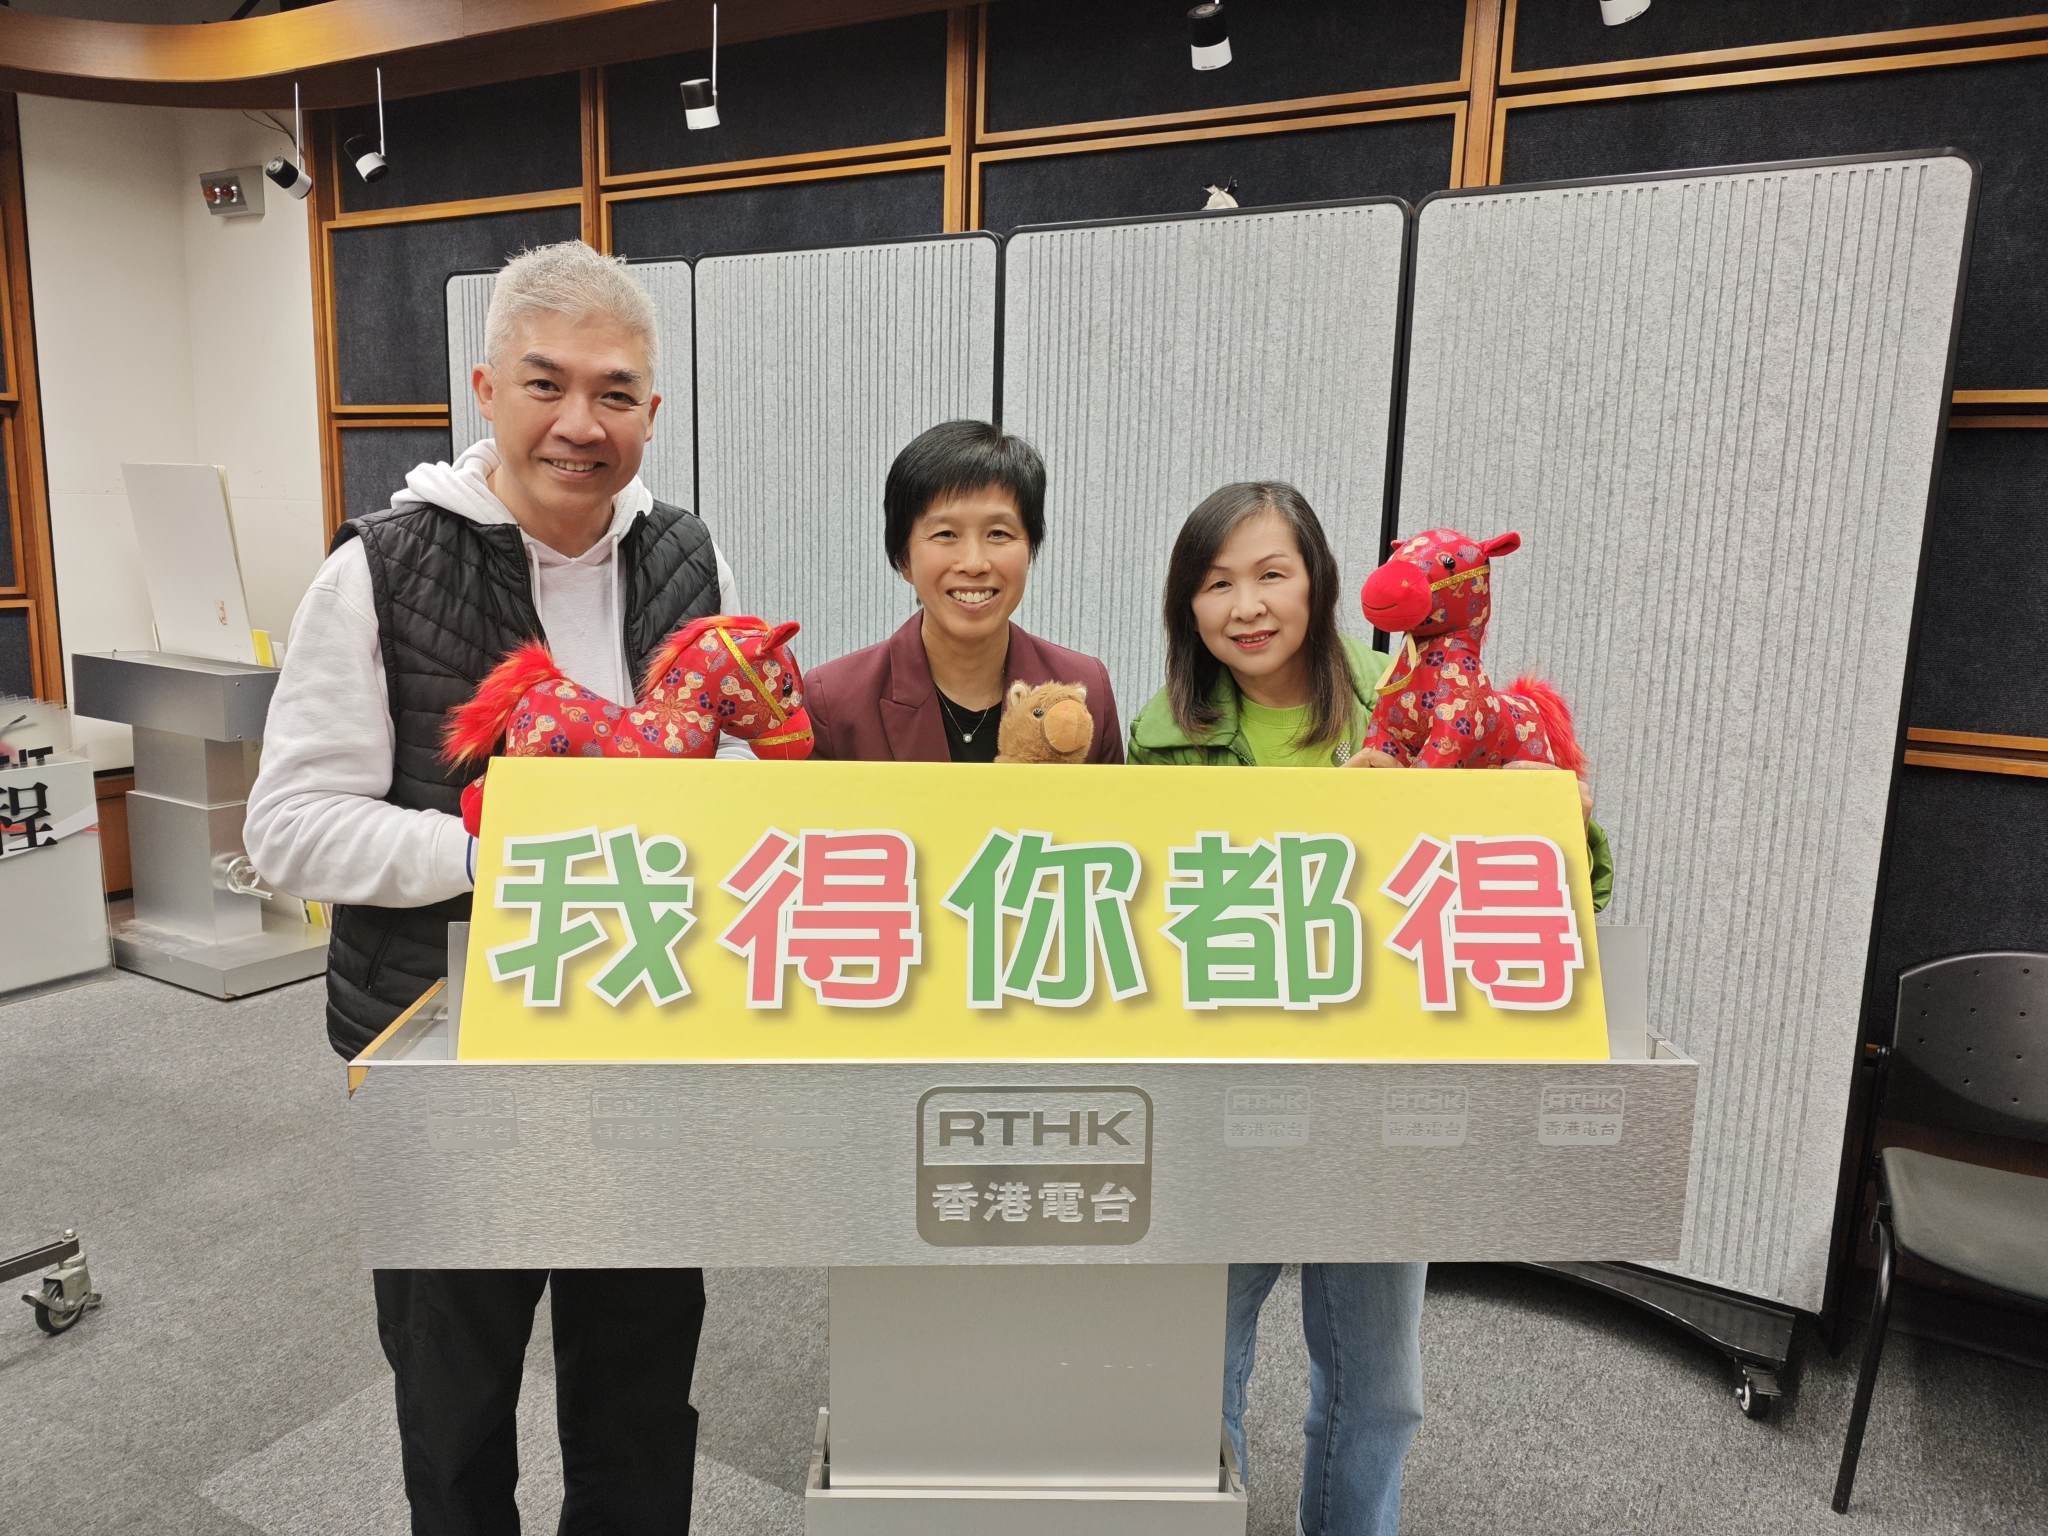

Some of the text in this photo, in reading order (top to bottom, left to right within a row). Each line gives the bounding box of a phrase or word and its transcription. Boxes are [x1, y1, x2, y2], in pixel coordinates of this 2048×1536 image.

[486, 823, 1584, 1011] 我得你都得
[939, 1110, 1133, 1147] RTHK
[932, 1181, 1137, 1223] 香港電台
